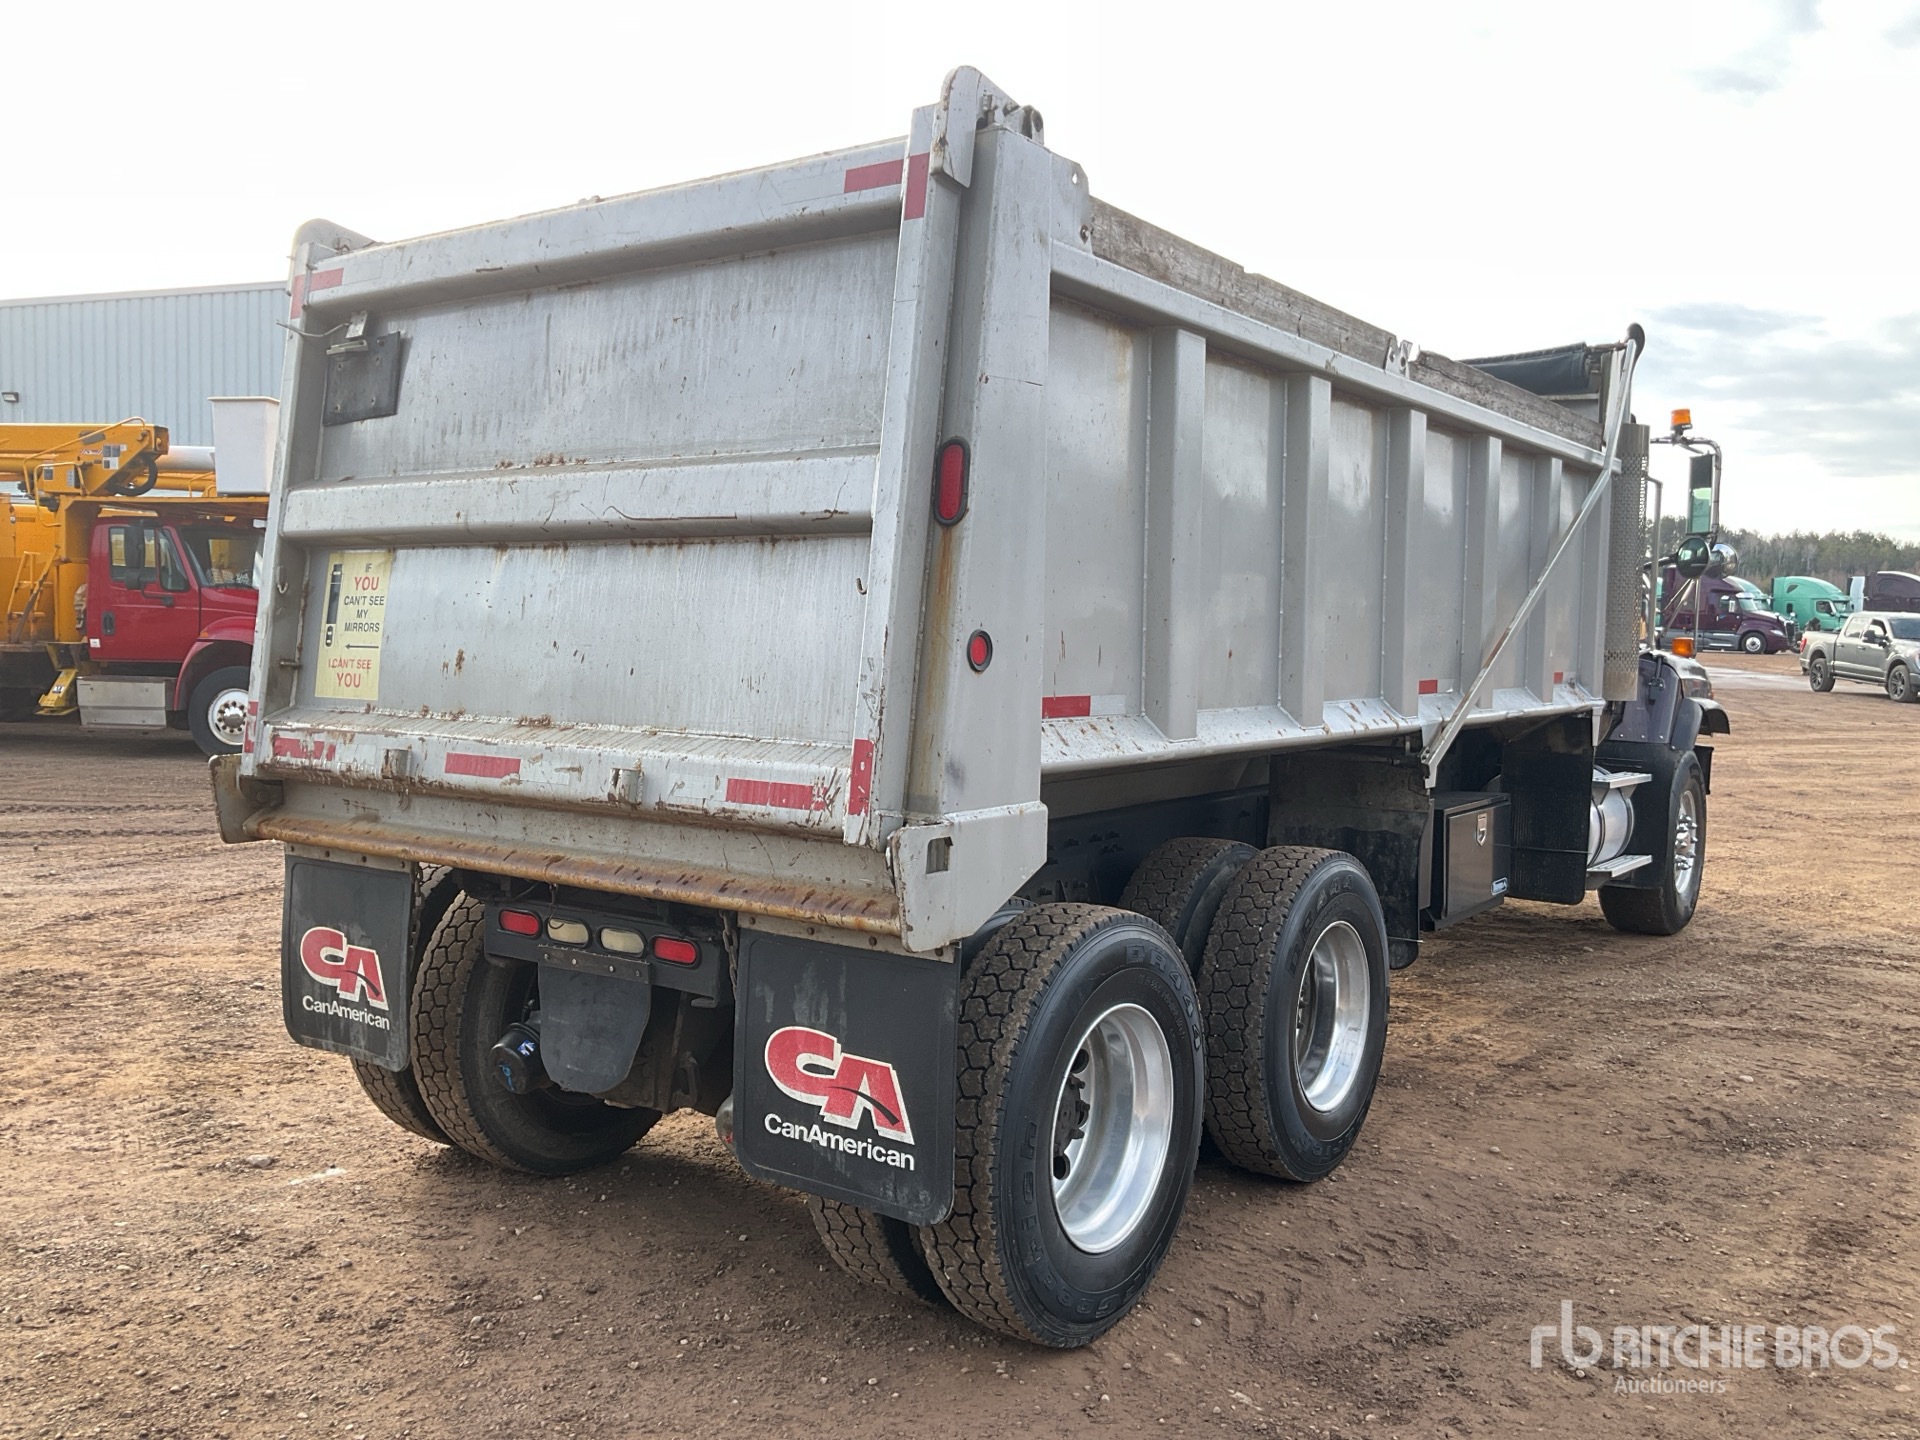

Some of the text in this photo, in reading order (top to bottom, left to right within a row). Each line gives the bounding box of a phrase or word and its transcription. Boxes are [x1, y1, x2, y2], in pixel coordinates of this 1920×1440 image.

[365, 563, 372, 573] IF
[354, 576, 380, 591] YOU
[344, 595, 385, 606] CAN'T SEE
[356, 609, 369, 619] MY
[344, 622, 380, 633] MIRRORS
[356, 659, 372, 670] SEE
[336, 672, 361, 688] YOU
[300, 926, 389, 1010] CA
[302, 995, 390, 1030] CanAmerican
[764, 1026, 915, 1145] CA
[764, 1113, 915, 1171] CanAmerican
